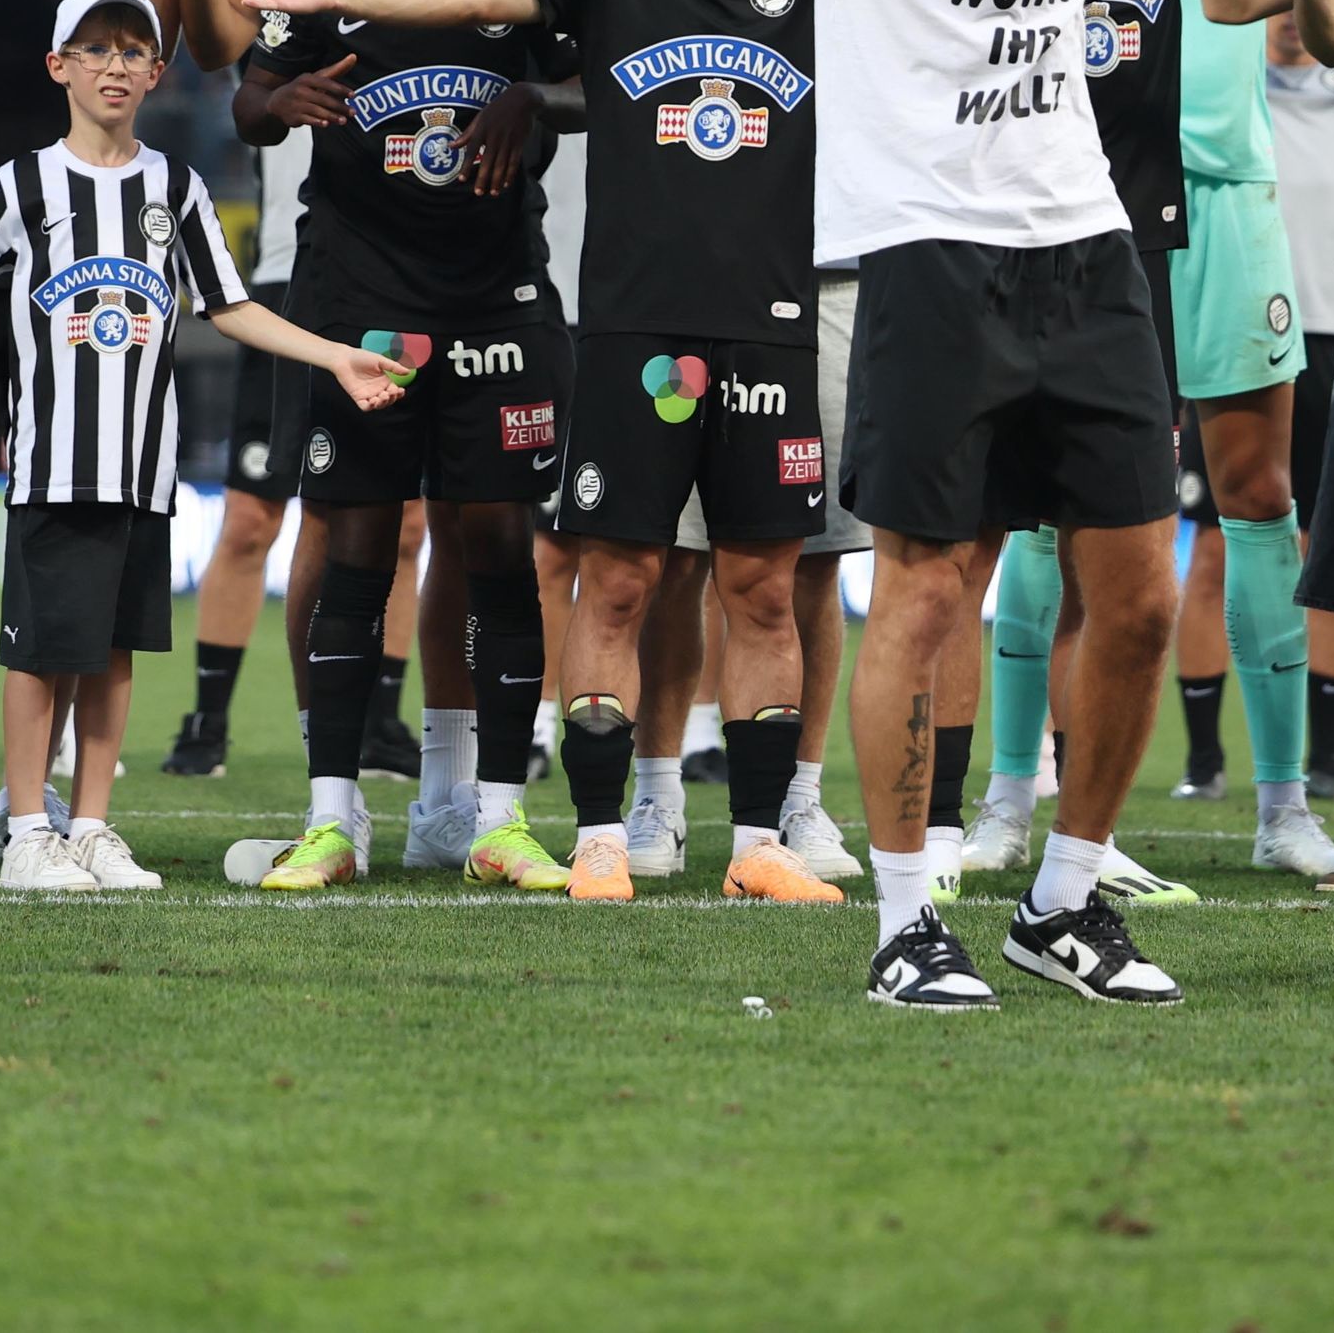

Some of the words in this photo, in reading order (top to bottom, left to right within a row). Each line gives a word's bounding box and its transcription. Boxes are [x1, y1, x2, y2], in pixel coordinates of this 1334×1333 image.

[622, 42, 802, 102] PUNTIGAMER
[43, 263, 115, 306] SAMMA
[118, 265, 170, 310] STURM
